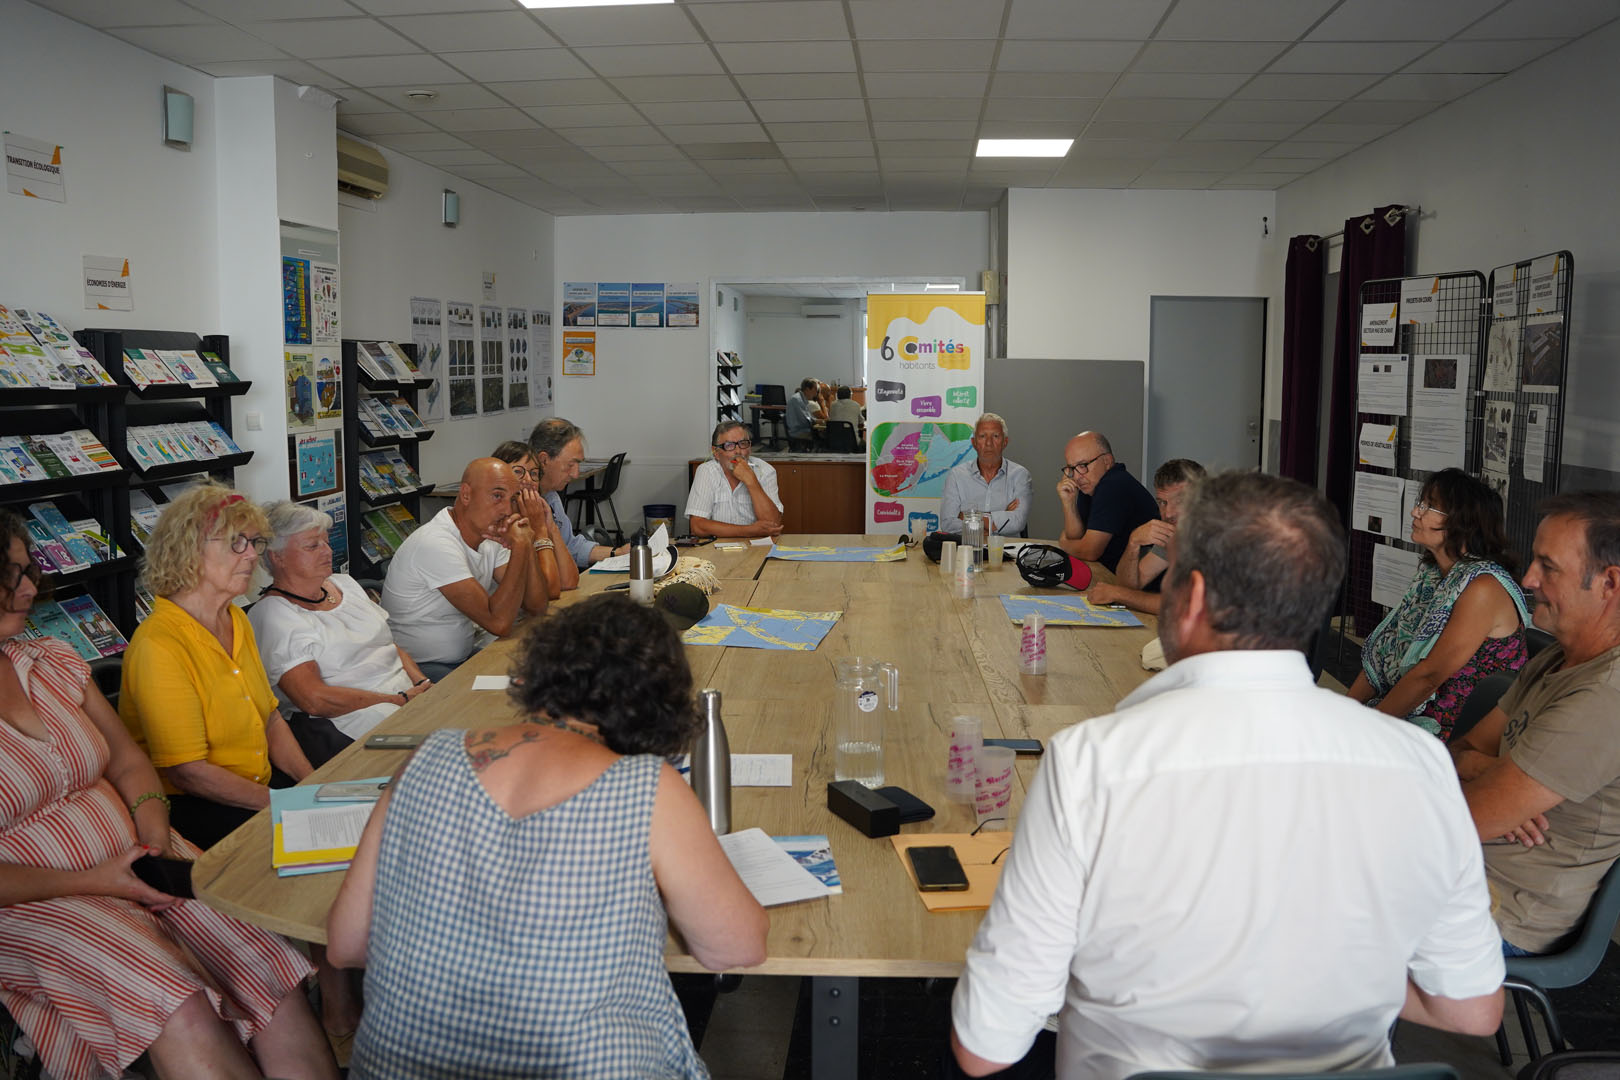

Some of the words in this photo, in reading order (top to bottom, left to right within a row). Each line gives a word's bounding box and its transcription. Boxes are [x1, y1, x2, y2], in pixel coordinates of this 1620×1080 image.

[6, 154, 33, 168] TRANSITION
[880, 336, 894, 361] 6
[899, 362, 936, 370] habitants
